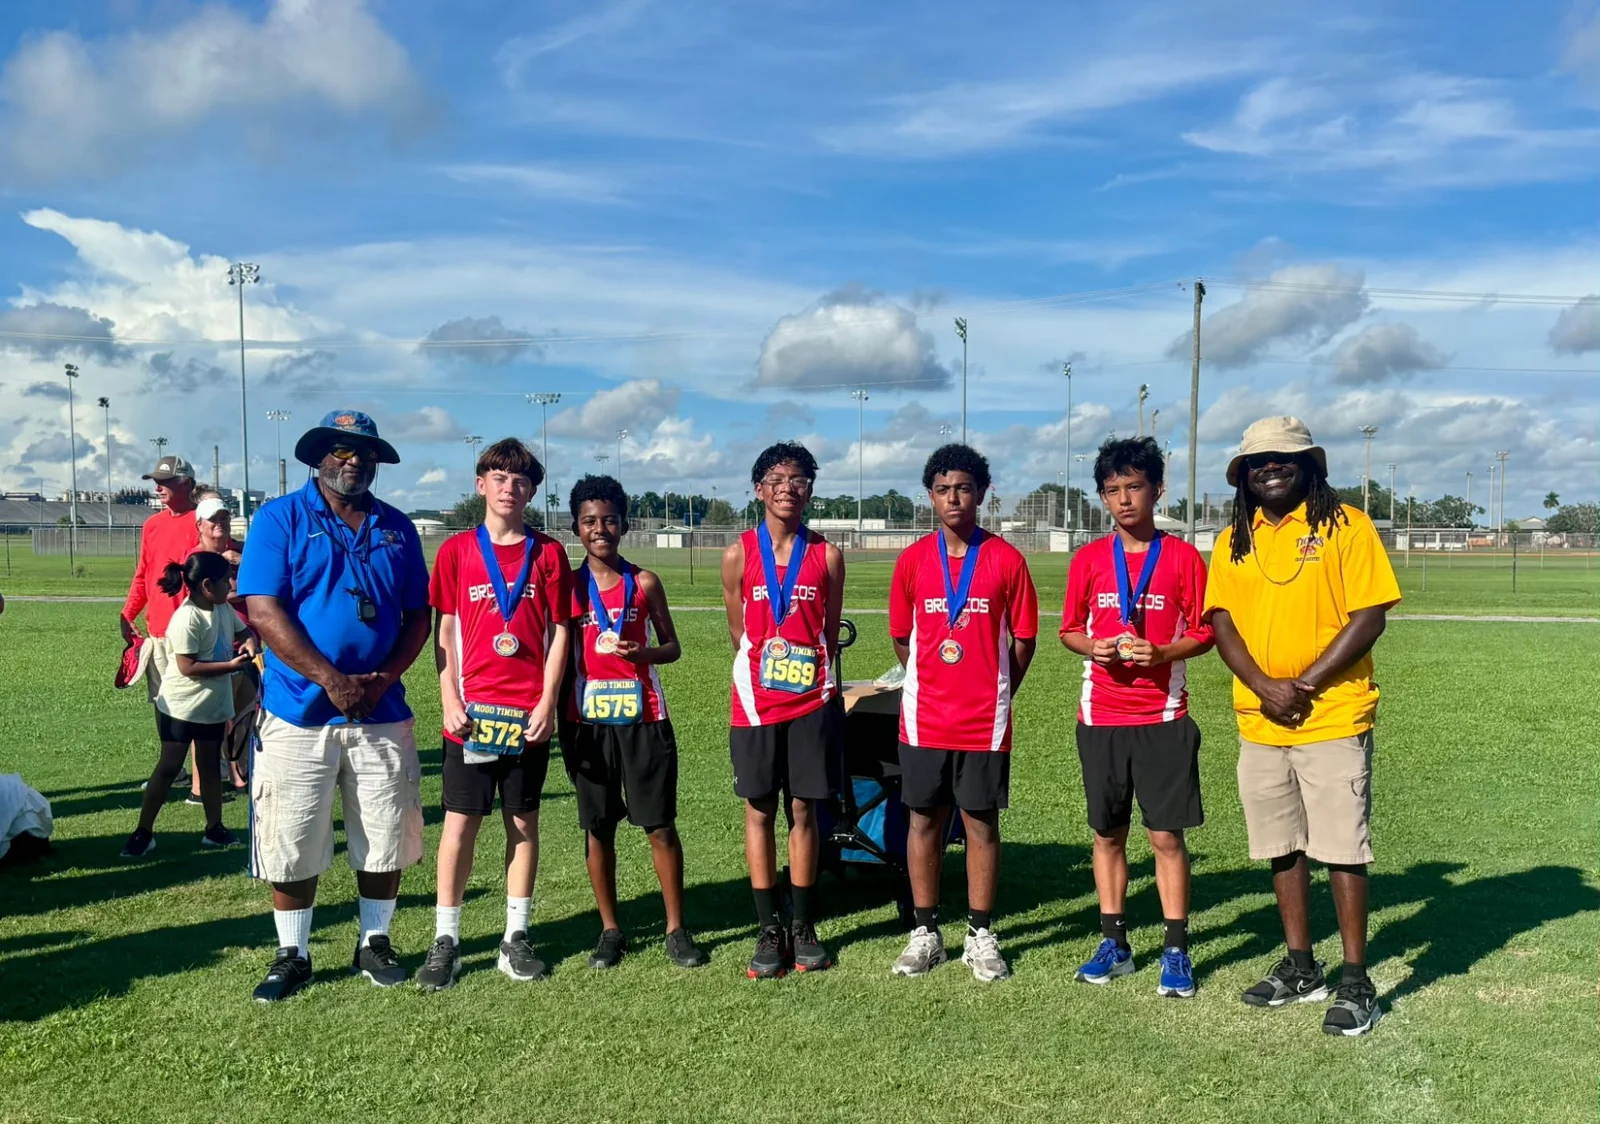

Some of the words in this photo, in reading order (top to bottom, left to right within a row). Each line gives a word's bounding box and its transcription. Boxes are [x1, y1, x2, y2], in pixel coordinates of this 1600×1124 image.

[469, 583, 536, 602] BROS
[753, 585, 817, 601] BRCOS
[924, 597, 989, 613] BROCOS
[1098, 593, 1165, 610] BROCOS
[791, 646, 816, 657] TIMING
[764, 658, 815, 686] 1569
[609, 680, 636, 689] TIMING
[497, 707, 524, 718] TIMING
[586, 694, 638, 718] 1575
[469, 718, 523, 747] 1572
